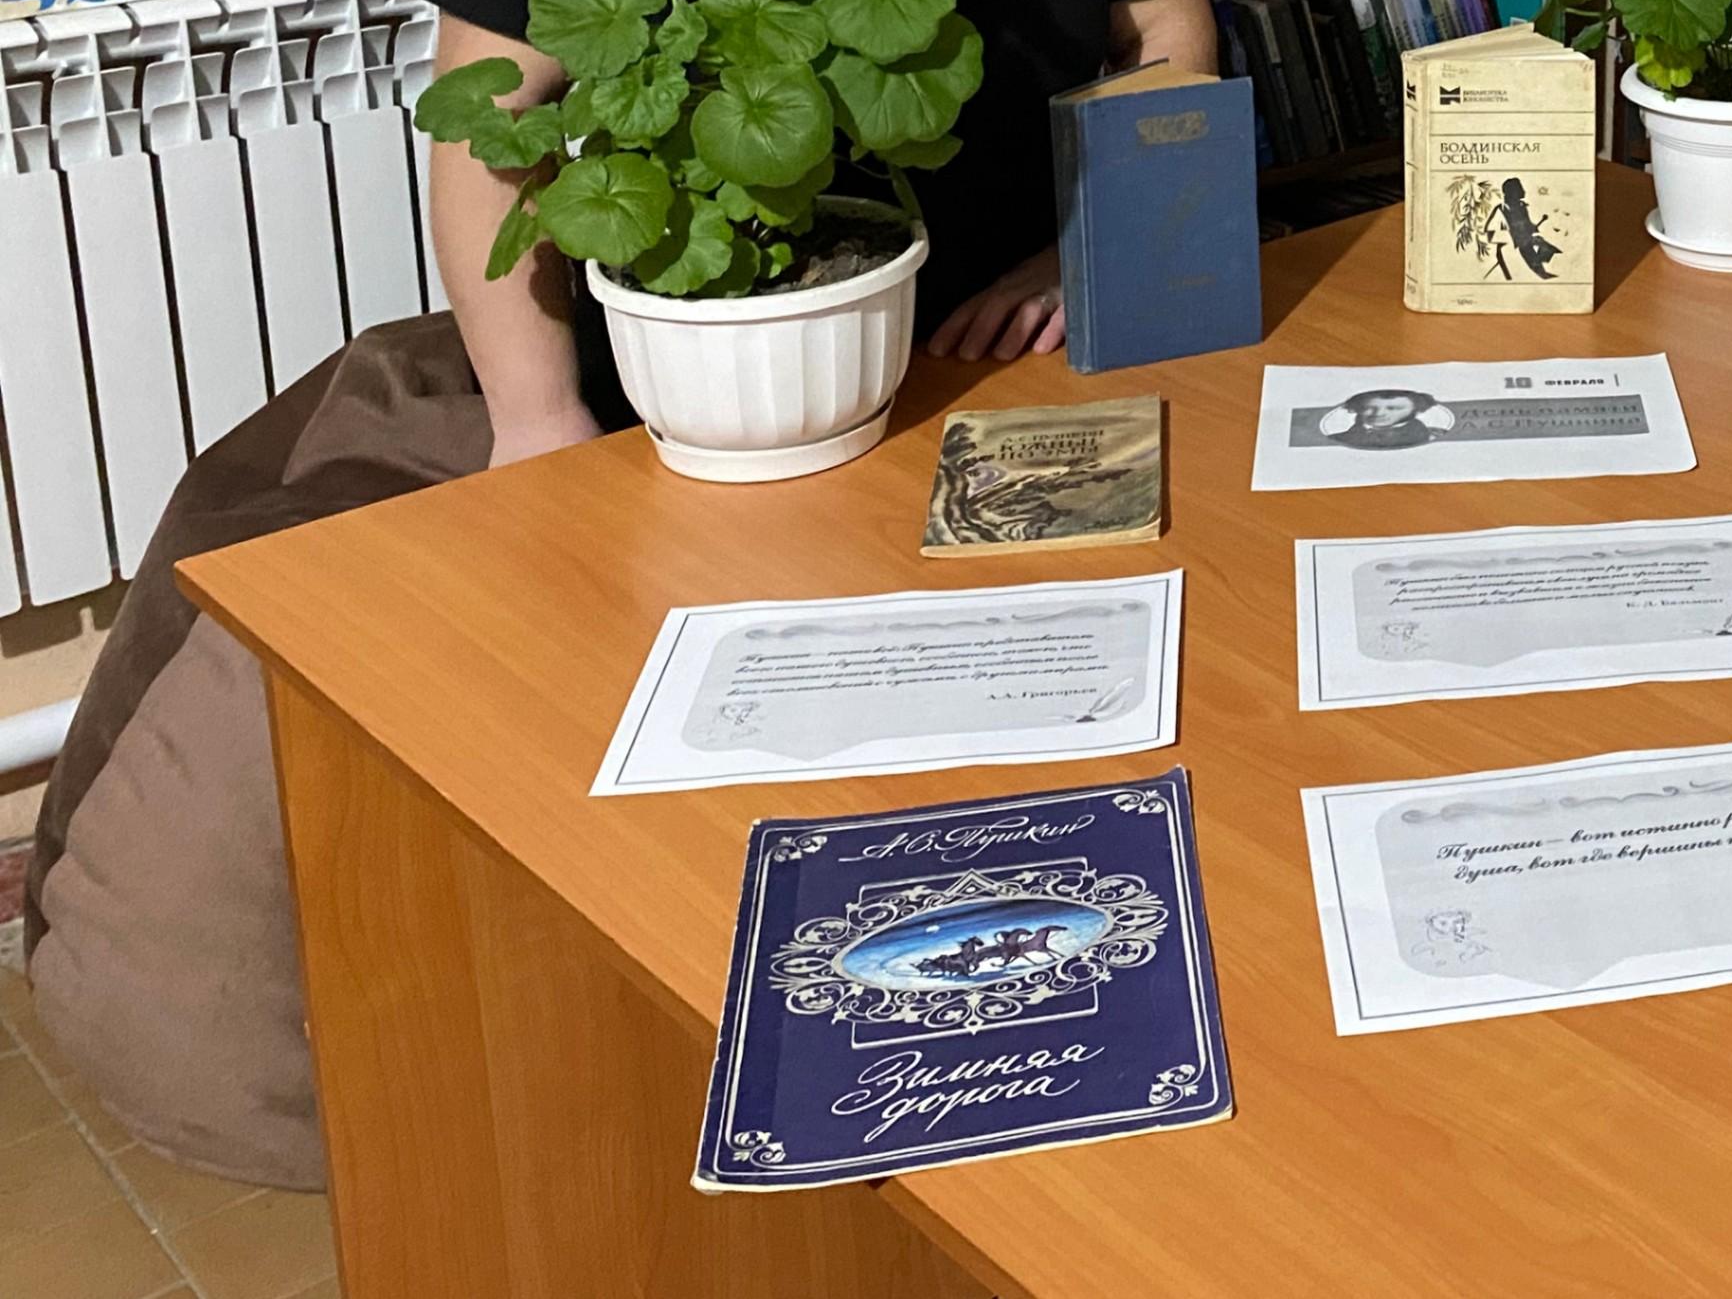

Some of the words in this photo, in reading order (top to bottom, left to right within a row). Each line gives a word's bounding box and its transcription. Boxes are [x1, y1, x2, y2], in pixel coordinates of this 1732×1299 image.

[1440, 142, 1541, 154] БОЛДИНСКАЯ
[1440, 153, 1489, 164] ОСЕНЬ
[1544, 378, 1605, 386] ФЕВРАЛЯ
[1436, 837, 1543, 861] Пушкин
[1570, 827, 1616, 844] вот
[1621, 818, 1721, 838] истинно
[1528, 855, 1574, 871] вот
[1616, 836, 1722, 861] вершины
[831, 1042, 1104, 1116] Зимняя
[864, 1077, 1079, 1143] дорога
